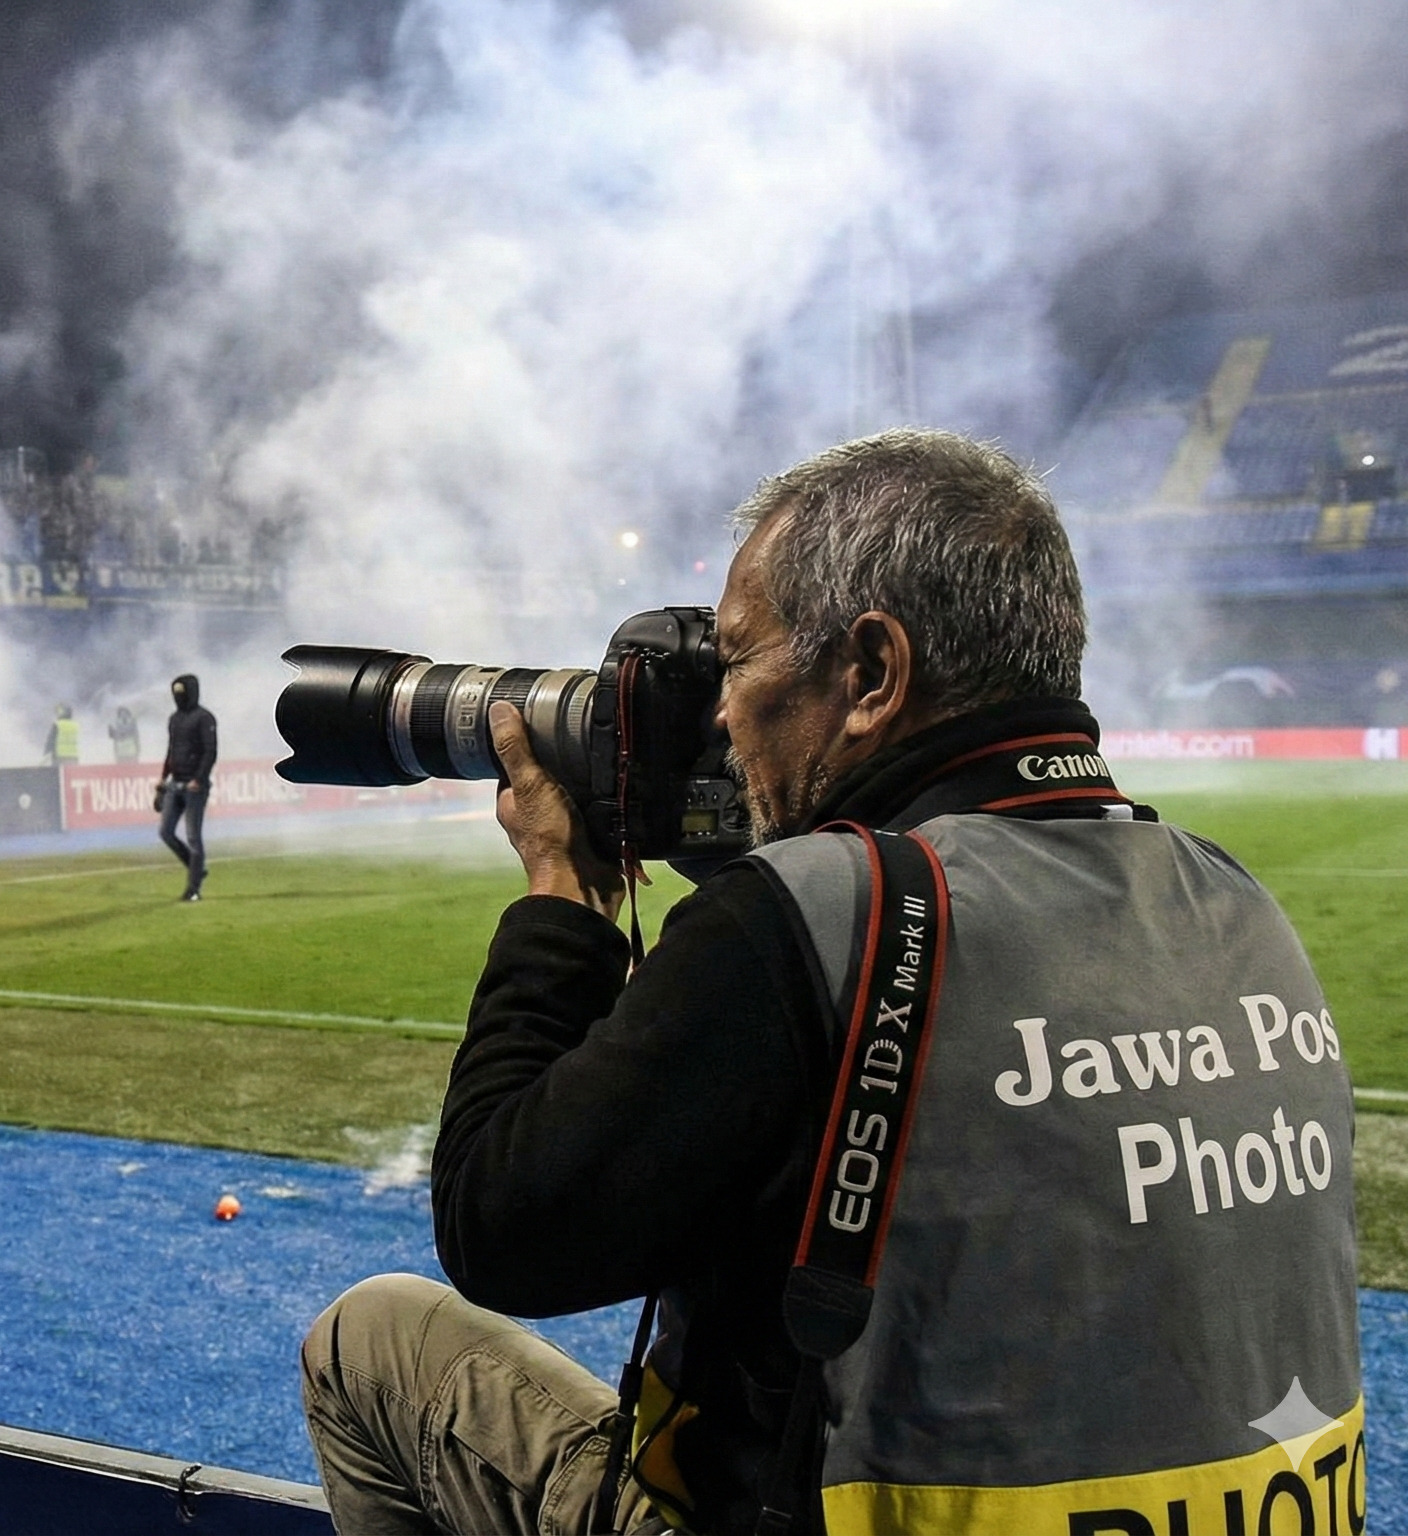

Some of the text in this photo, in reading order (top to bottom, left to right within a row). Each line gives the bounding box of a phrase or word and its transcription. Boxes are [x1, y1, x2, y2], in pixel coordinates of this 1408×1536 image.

[1017, 753, 1109, 781] Canon
[828, 895, 926, 1233] EOS 1D X Mark III
[995, 993, 1340, 1107] Jawa Pos
[1117, 1105, 1332, 1224] Photo
[1068, 1430, 1366, 1536] OTO
